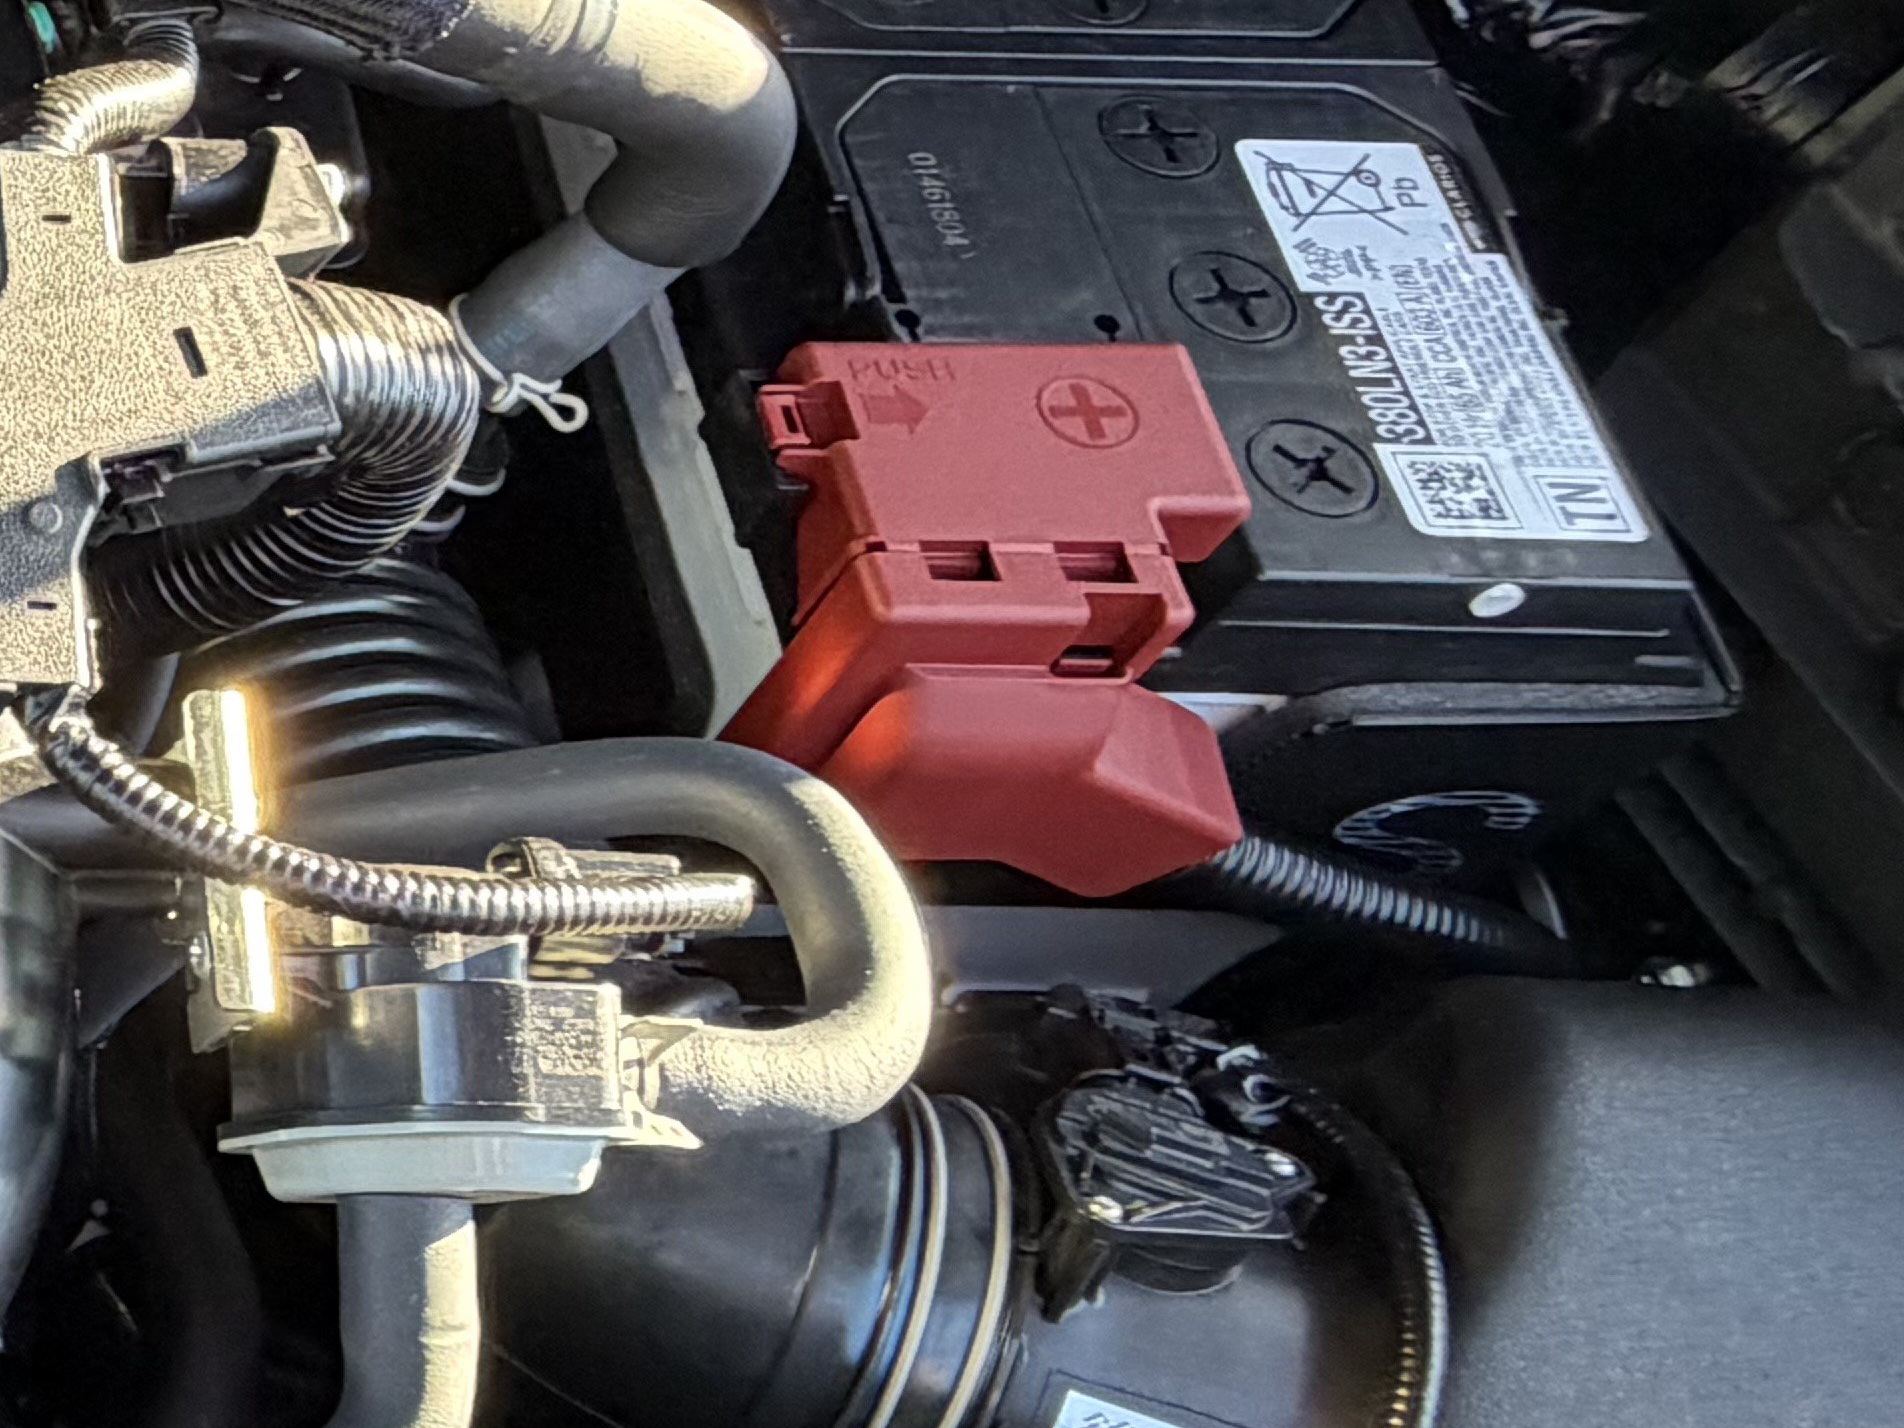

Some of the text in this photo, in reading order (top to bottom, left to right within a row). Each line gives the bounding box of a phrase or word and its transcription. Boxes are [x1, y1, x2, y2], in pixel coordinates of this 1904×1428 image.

[1390, 177, 1430, 208] Pb
[847, 358, 957, 383] PUSH
[1314, 294, 1428, 445] 380LN3-ISS
[1547, 481, 1620, 526] TN
